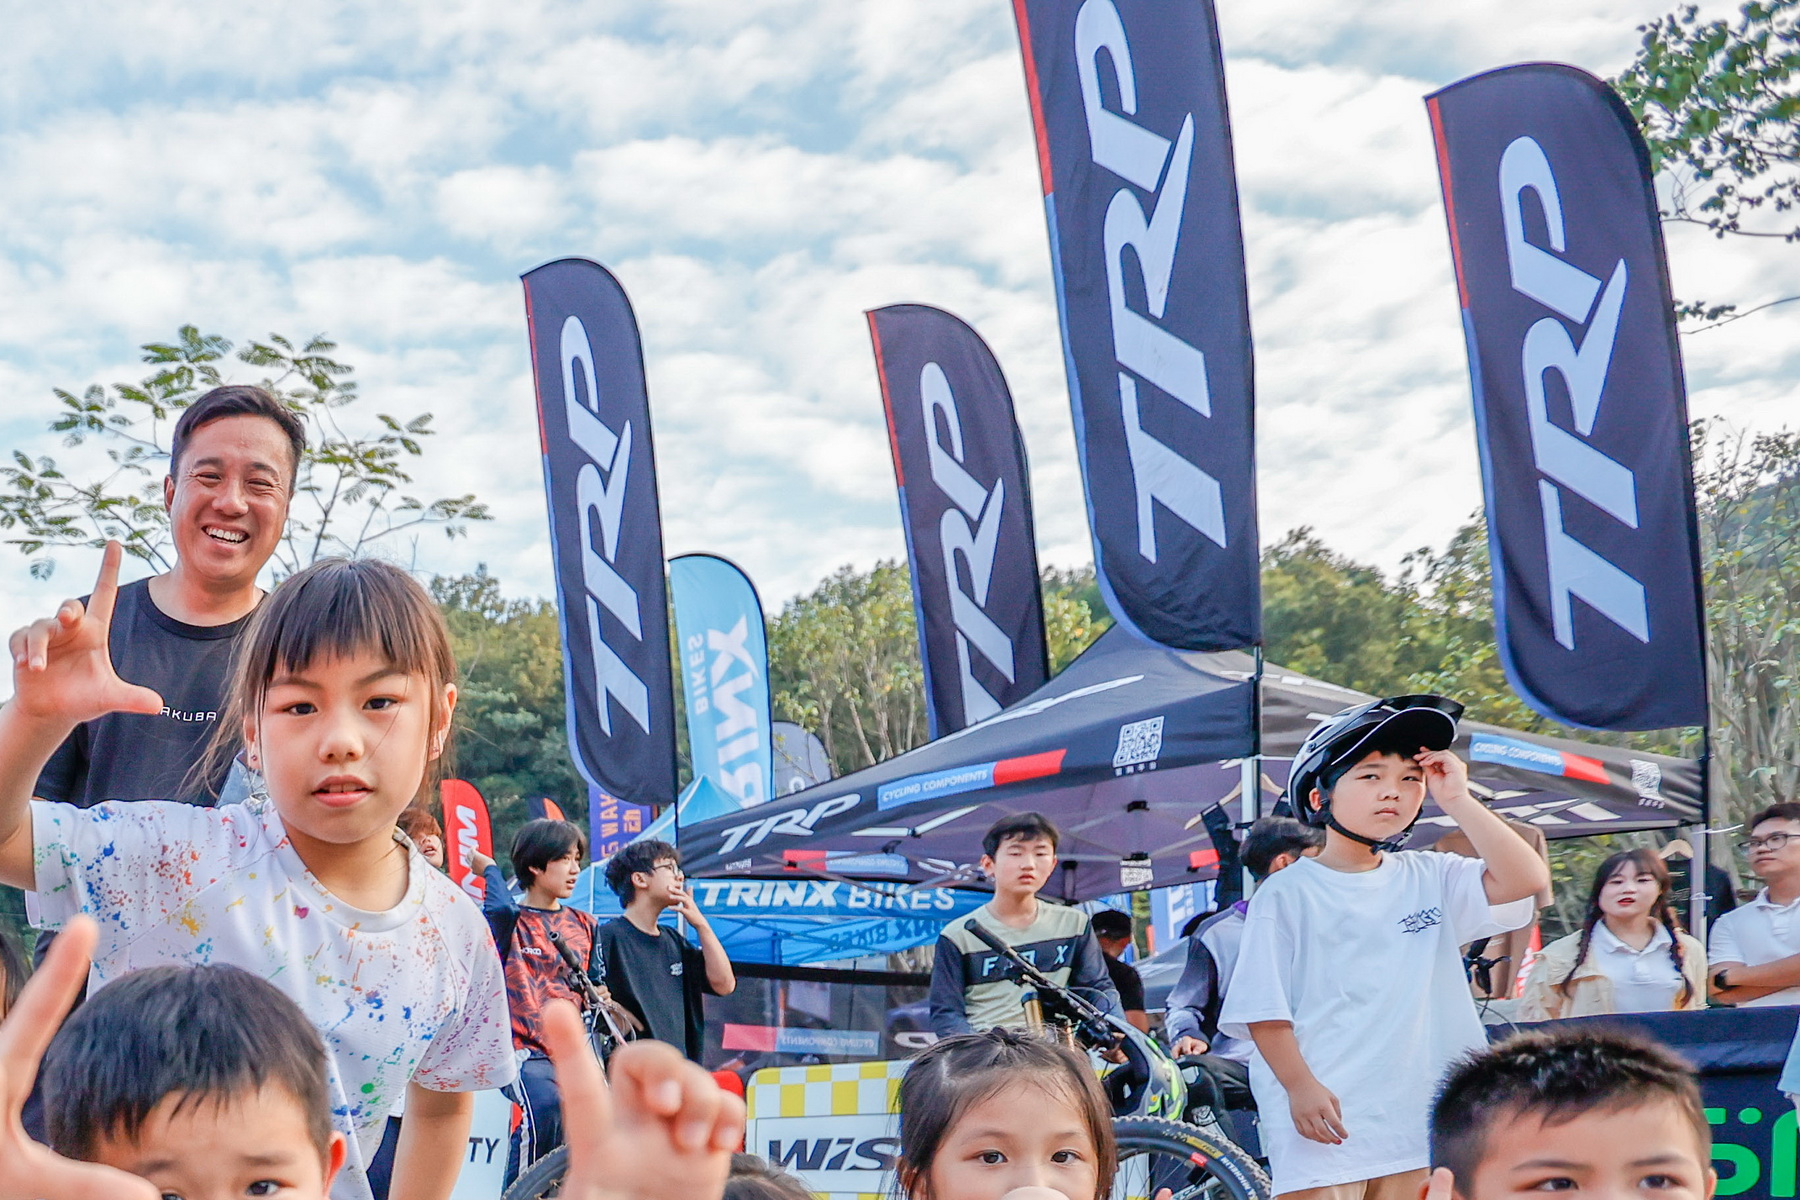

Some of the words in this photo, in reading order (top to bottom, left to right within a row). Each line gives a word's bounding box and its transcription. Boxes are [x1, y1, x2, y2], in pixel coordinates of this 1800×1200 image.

[1075, 0, 1226, 564] TRP
[1499, 136, 1649, 650] TRP
[560, 315, 650, 737] TRP
[919, 361, 1016, 726] TRP
[161, 706, 217, 722] AKUBA
[882, 782, 921, 803] CYCLING
[922, 771, 989, 793] COMPONENTS
[719, 794, 861, 855] TRP
[699, 880, 842, 907] TRINX
[848, 882, 955, 910] BIKES
[469, 1136, 501, 1164] TY
